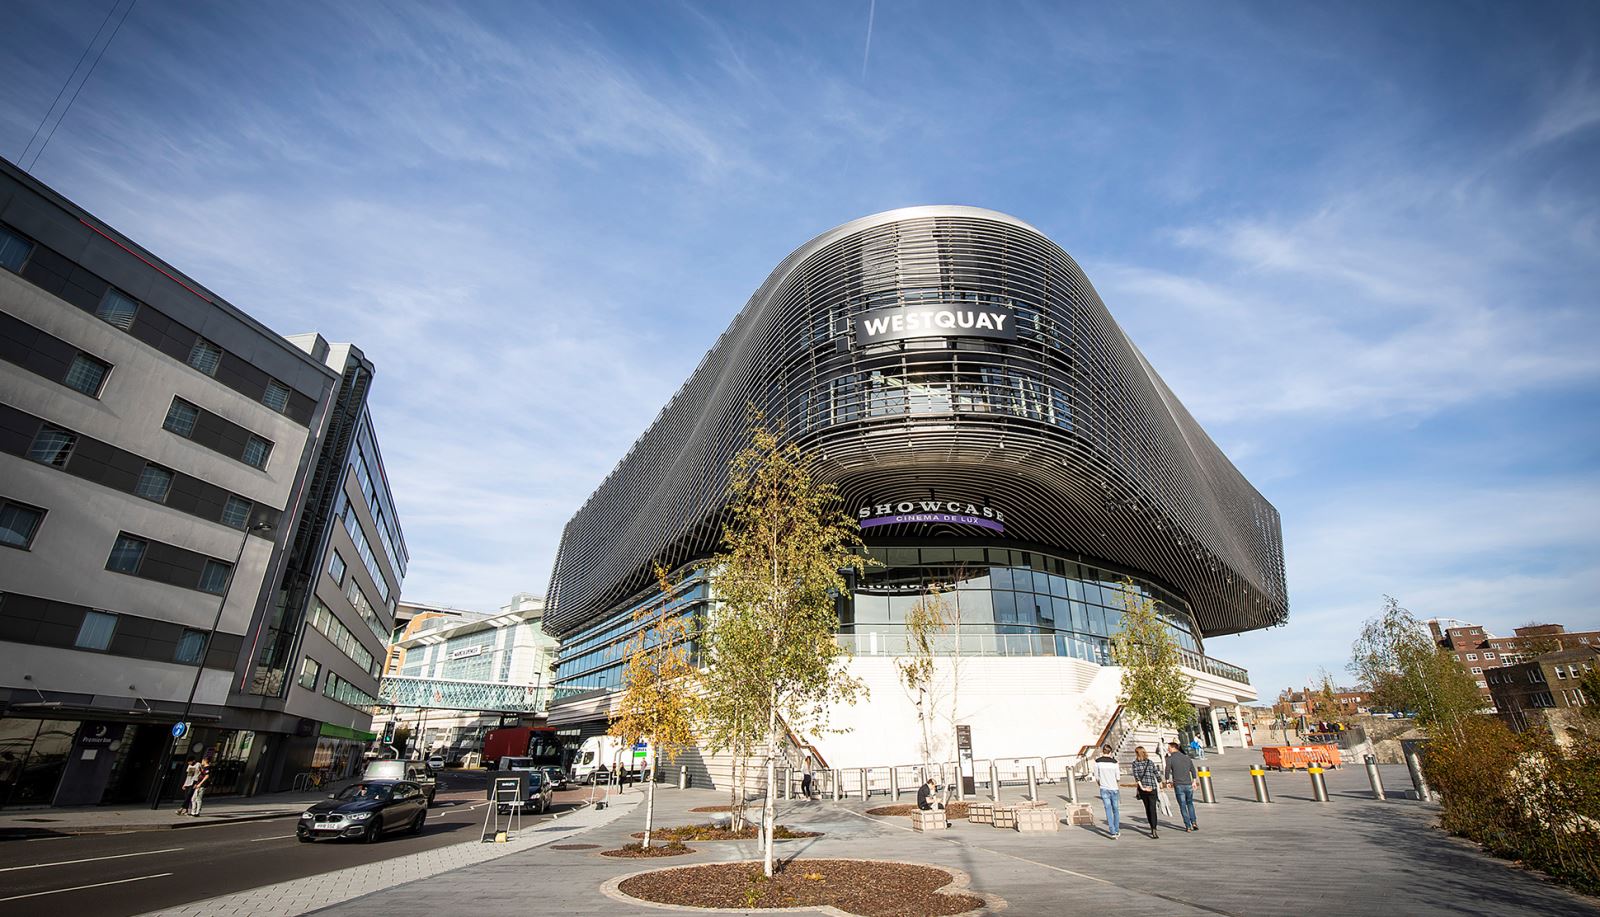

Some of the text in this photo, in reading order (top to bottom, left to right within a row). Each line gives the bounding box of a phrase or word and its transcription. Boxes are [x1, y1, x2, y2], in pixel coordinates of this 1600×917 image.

[864, 310, 1006, 336] WESTQUAY
[859, 501, 1005, 522] SHOWCASE
[961, 516, 979, 524] LUX
